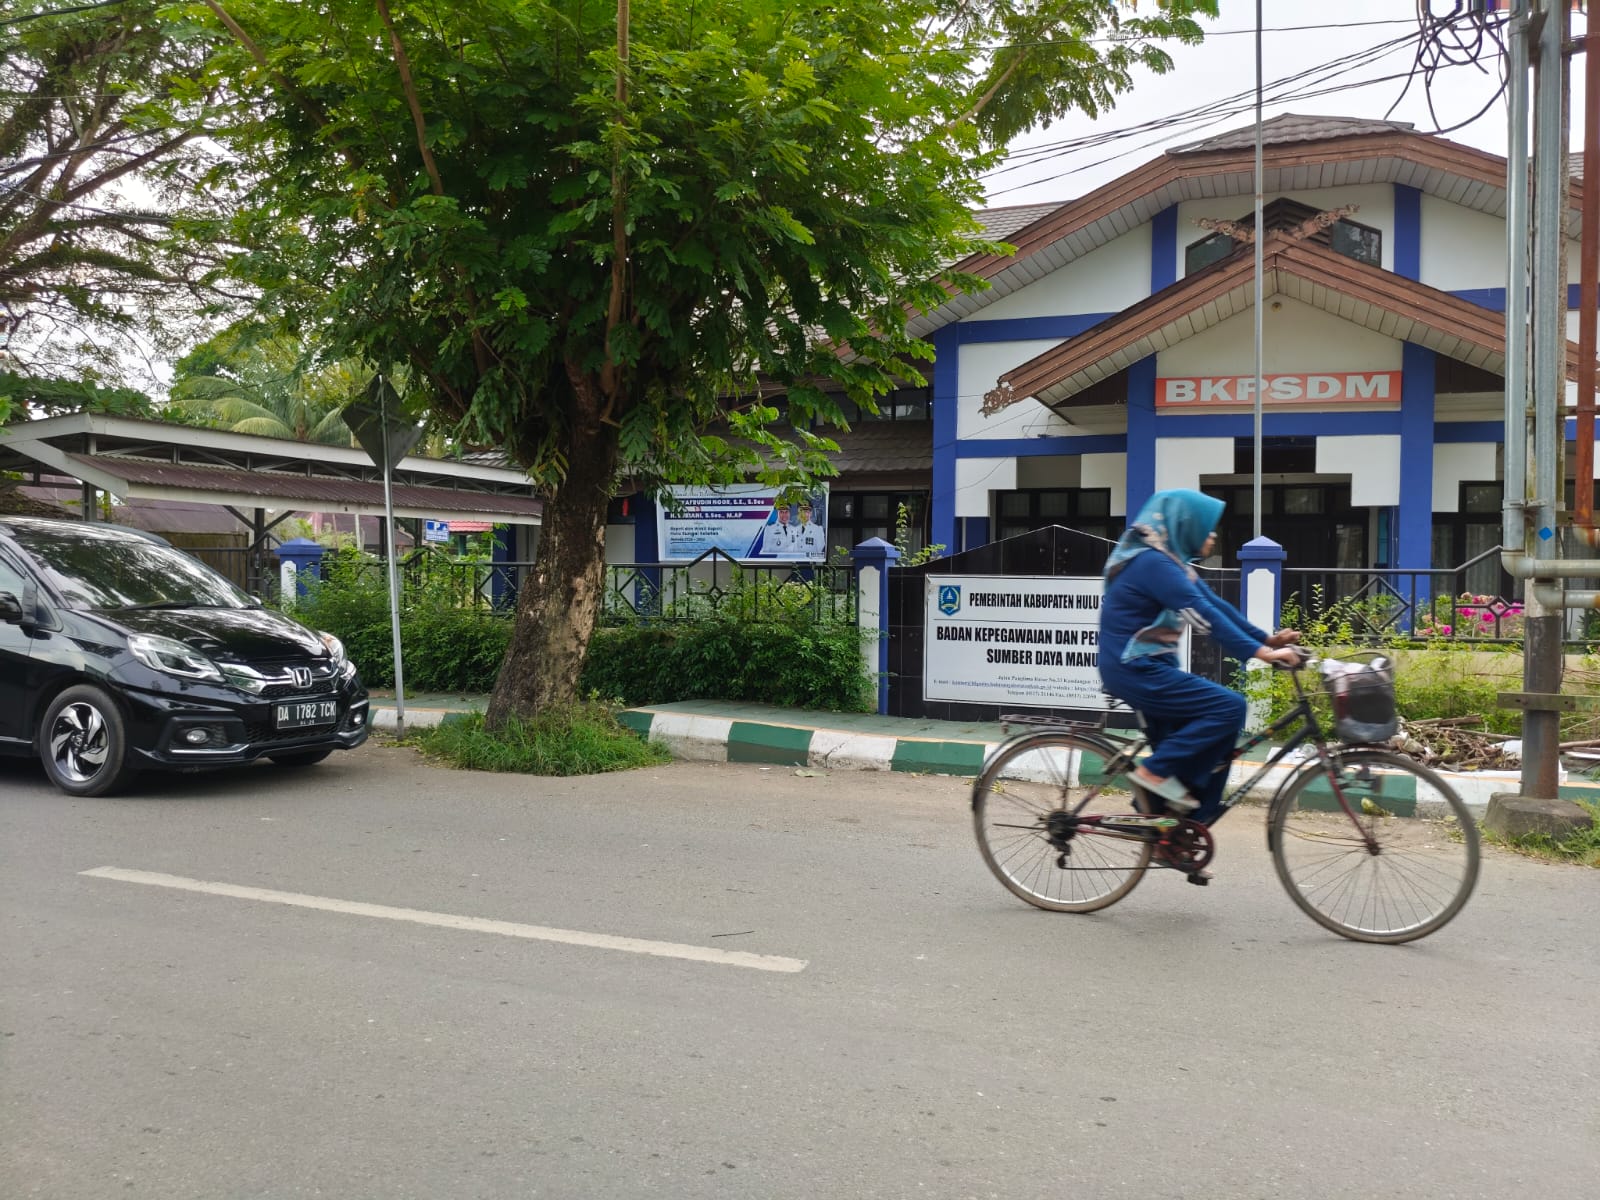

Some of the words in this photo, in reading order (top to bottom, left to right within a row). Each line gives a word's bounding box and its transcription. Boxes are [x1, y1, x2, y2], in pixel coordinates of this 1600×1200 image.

[1165, 374, 1390, 402] BKPSDM
[969, 592, 1022, 607] PEMERINTAH
[1023, 593, 1074, 609] KABUPATEN
[1076, 595, 1099, 610] HULU
[936, 626, 972, 641] BADAN
[974, 627, 1052, 645] KEPEGAWAIAN
[1055, 630, 1078, 645] DAN
[986, 649, 1032, 665] SUMBER
[1035, 650, 1063, 666] DAYA
[1066, 651, 1098, 668] MANU
[277, 706, 289, 721] DA
[296, 704, 317, 720] 1782
[320, 702, 336, 717] TCK
